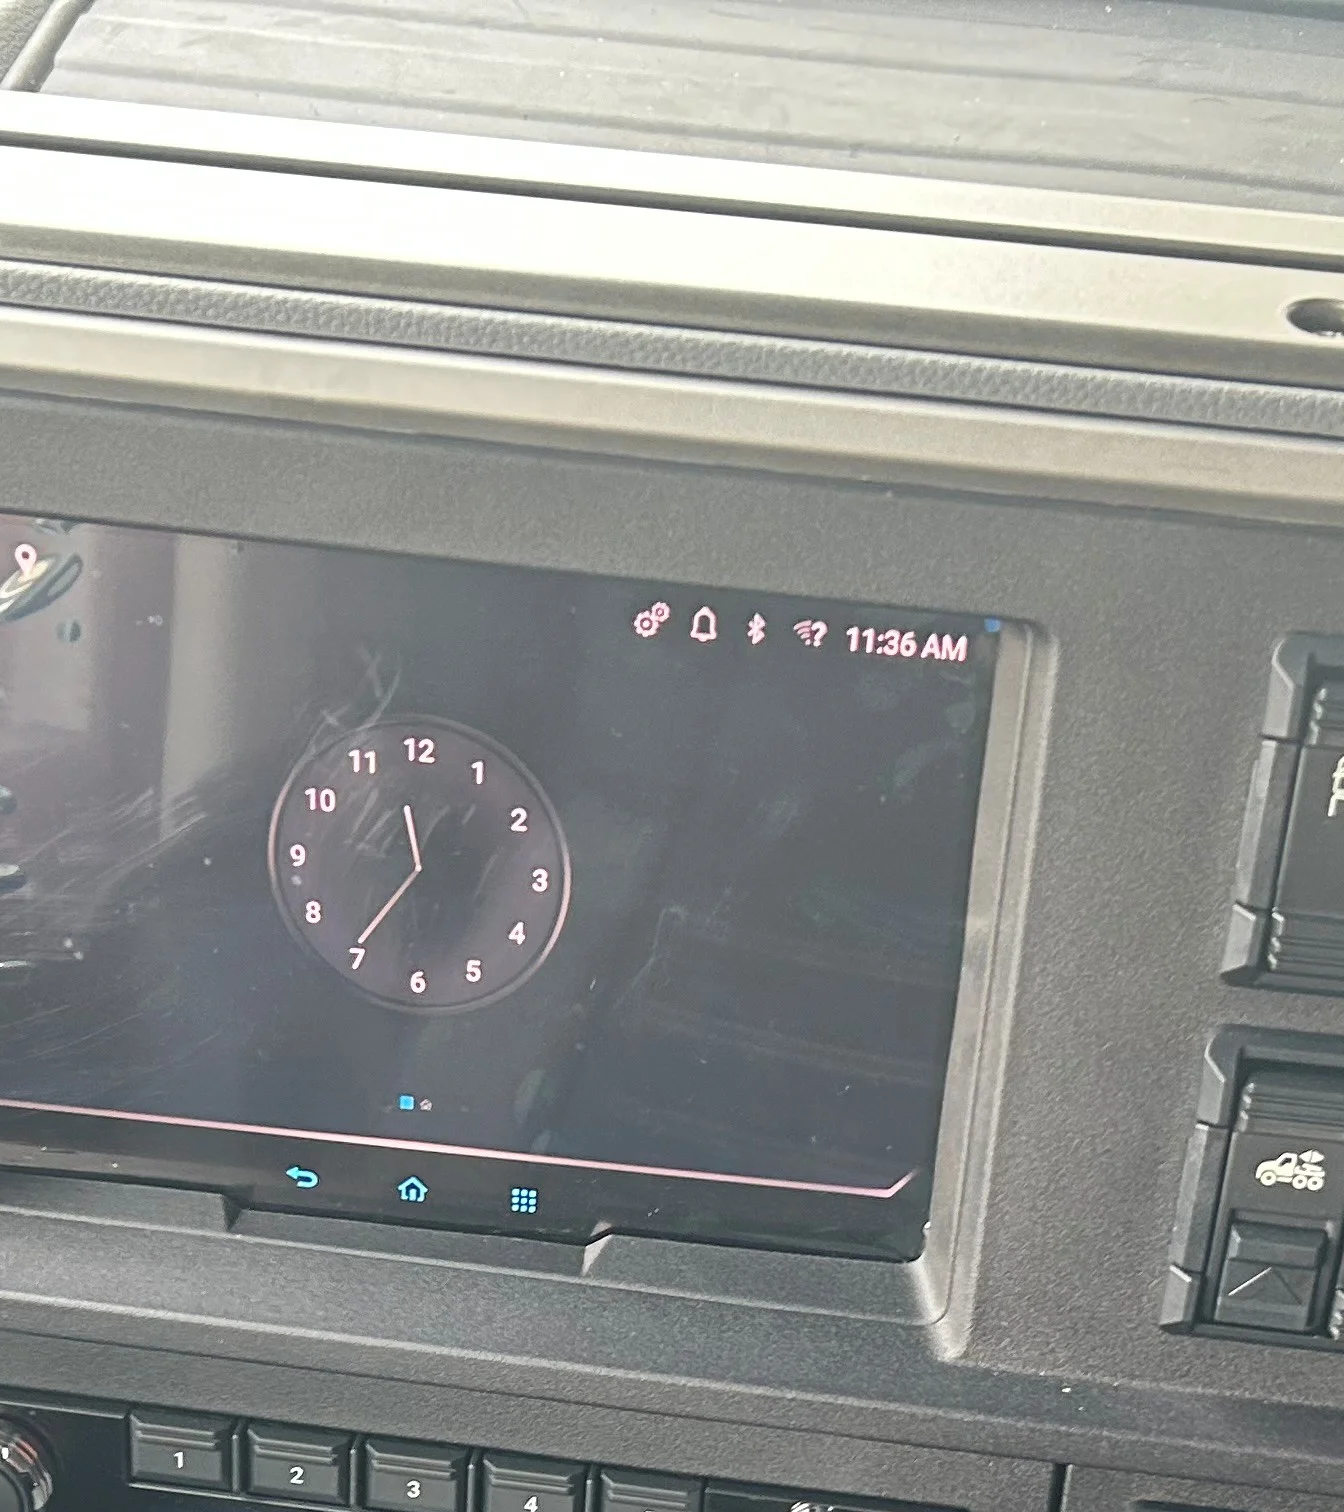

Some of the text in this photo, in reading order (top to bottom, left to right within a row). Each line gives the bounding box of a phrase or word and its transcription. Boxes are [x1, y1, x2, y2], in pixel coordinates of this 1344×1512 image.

[847, 627, 967, 661] 11:36 AM
[349, 750, 375, 773] 11
[404, 738, 435, 763] 12
[472, 761, 483, 784] 1
[305, 788, 335, 812] 10
[511, 808, 527, 832] 2
[290, 844, 305, 867] 9
[532, 869, 548, 892] 3
[306, 901, 321, 923] 8
[509, 922, 525, 945] 4
[349, 948, 365, 969] 7
[410, 972, 426, 993] 6
[466, 960, 481, 982] 5
[174, 1452, 183, 1468] 1
[290, 1467, 304, 1484] 2
[407, 1481, 420, 1498] 3
[524, 1497, 538, 1512] 4
